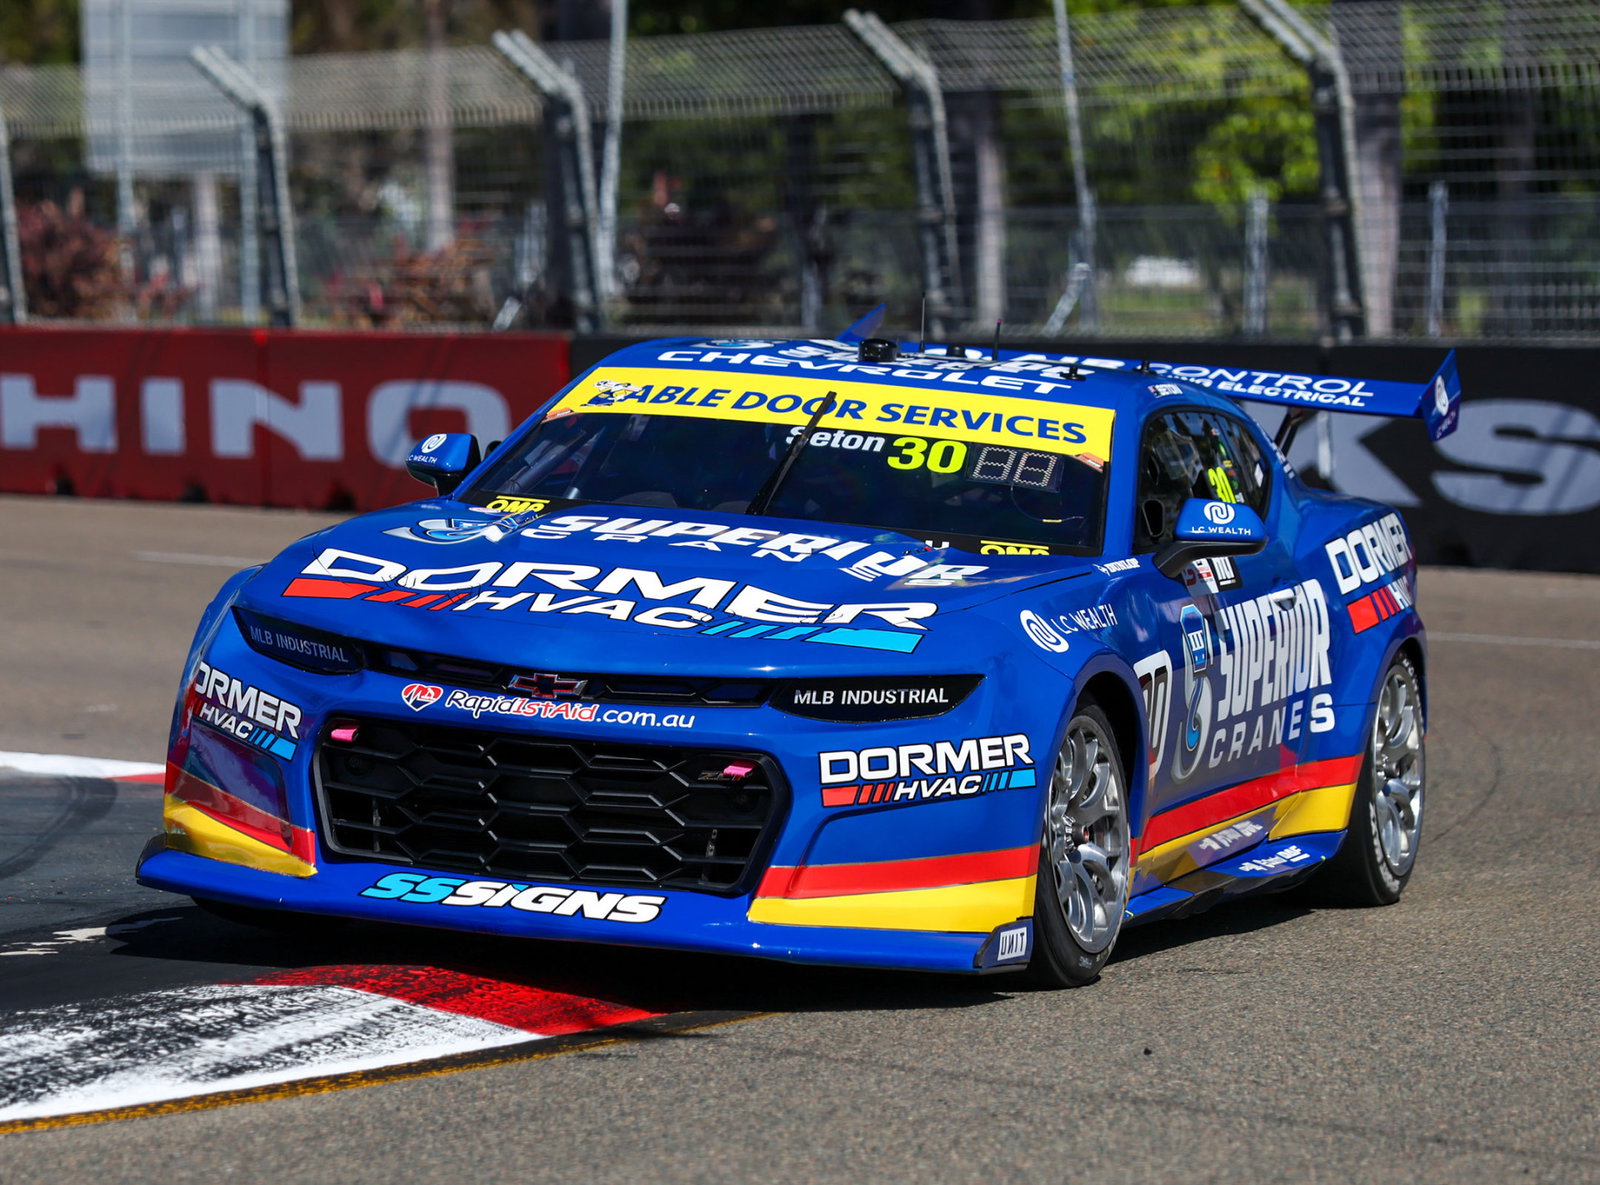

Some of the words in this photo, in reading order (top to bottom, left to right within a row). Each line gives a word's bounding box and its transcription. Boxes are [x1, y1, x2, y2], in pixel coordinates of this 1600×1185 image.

[657, 350, 1073, 395] CHEVROLET
[1136, 362, 1374, 397] CONTROL
[1217, 380, 1366, 407] ELECTRICAL
[0, 373, 512, 470] HINO
[617, 384, 732, 408] ABLE
[730, 390, 866, 420] DOOR
[875, 403, 1086, 444] SERVICES
[785, 425, 886, 452] Seton
[886, 436, 968, 474] 30
[486, 496, 550, 514] OMP
[1208, 526, 1252, 536] WEALTH
[1324, 512, 1414, 595] DORMER
[300, 548, 938, 631] DORMER
[452, 591, 713, 630] HVAC
[1069, 603, 1119, 631] WEALTH
[249, 625, 273, 646] MLB
[276, 633, 349, 664] INDUSTRIAL
[1217, 579, 1332, 722] SUPERIOR
[195, 661, 302, 740] ORMER
[446, 689, 695, 729] Rapid1stAid.com.au
[793, 689, 835, 706] MLB
[840, 687, 949, 705] INDUSTRIAL
[200, 701, 253, 739] HVAC
[1208, 693, 1335, 769] CRANES
[820, 733, 1034, 785] DORMER
[893, 774, 982, 801] HVAC
